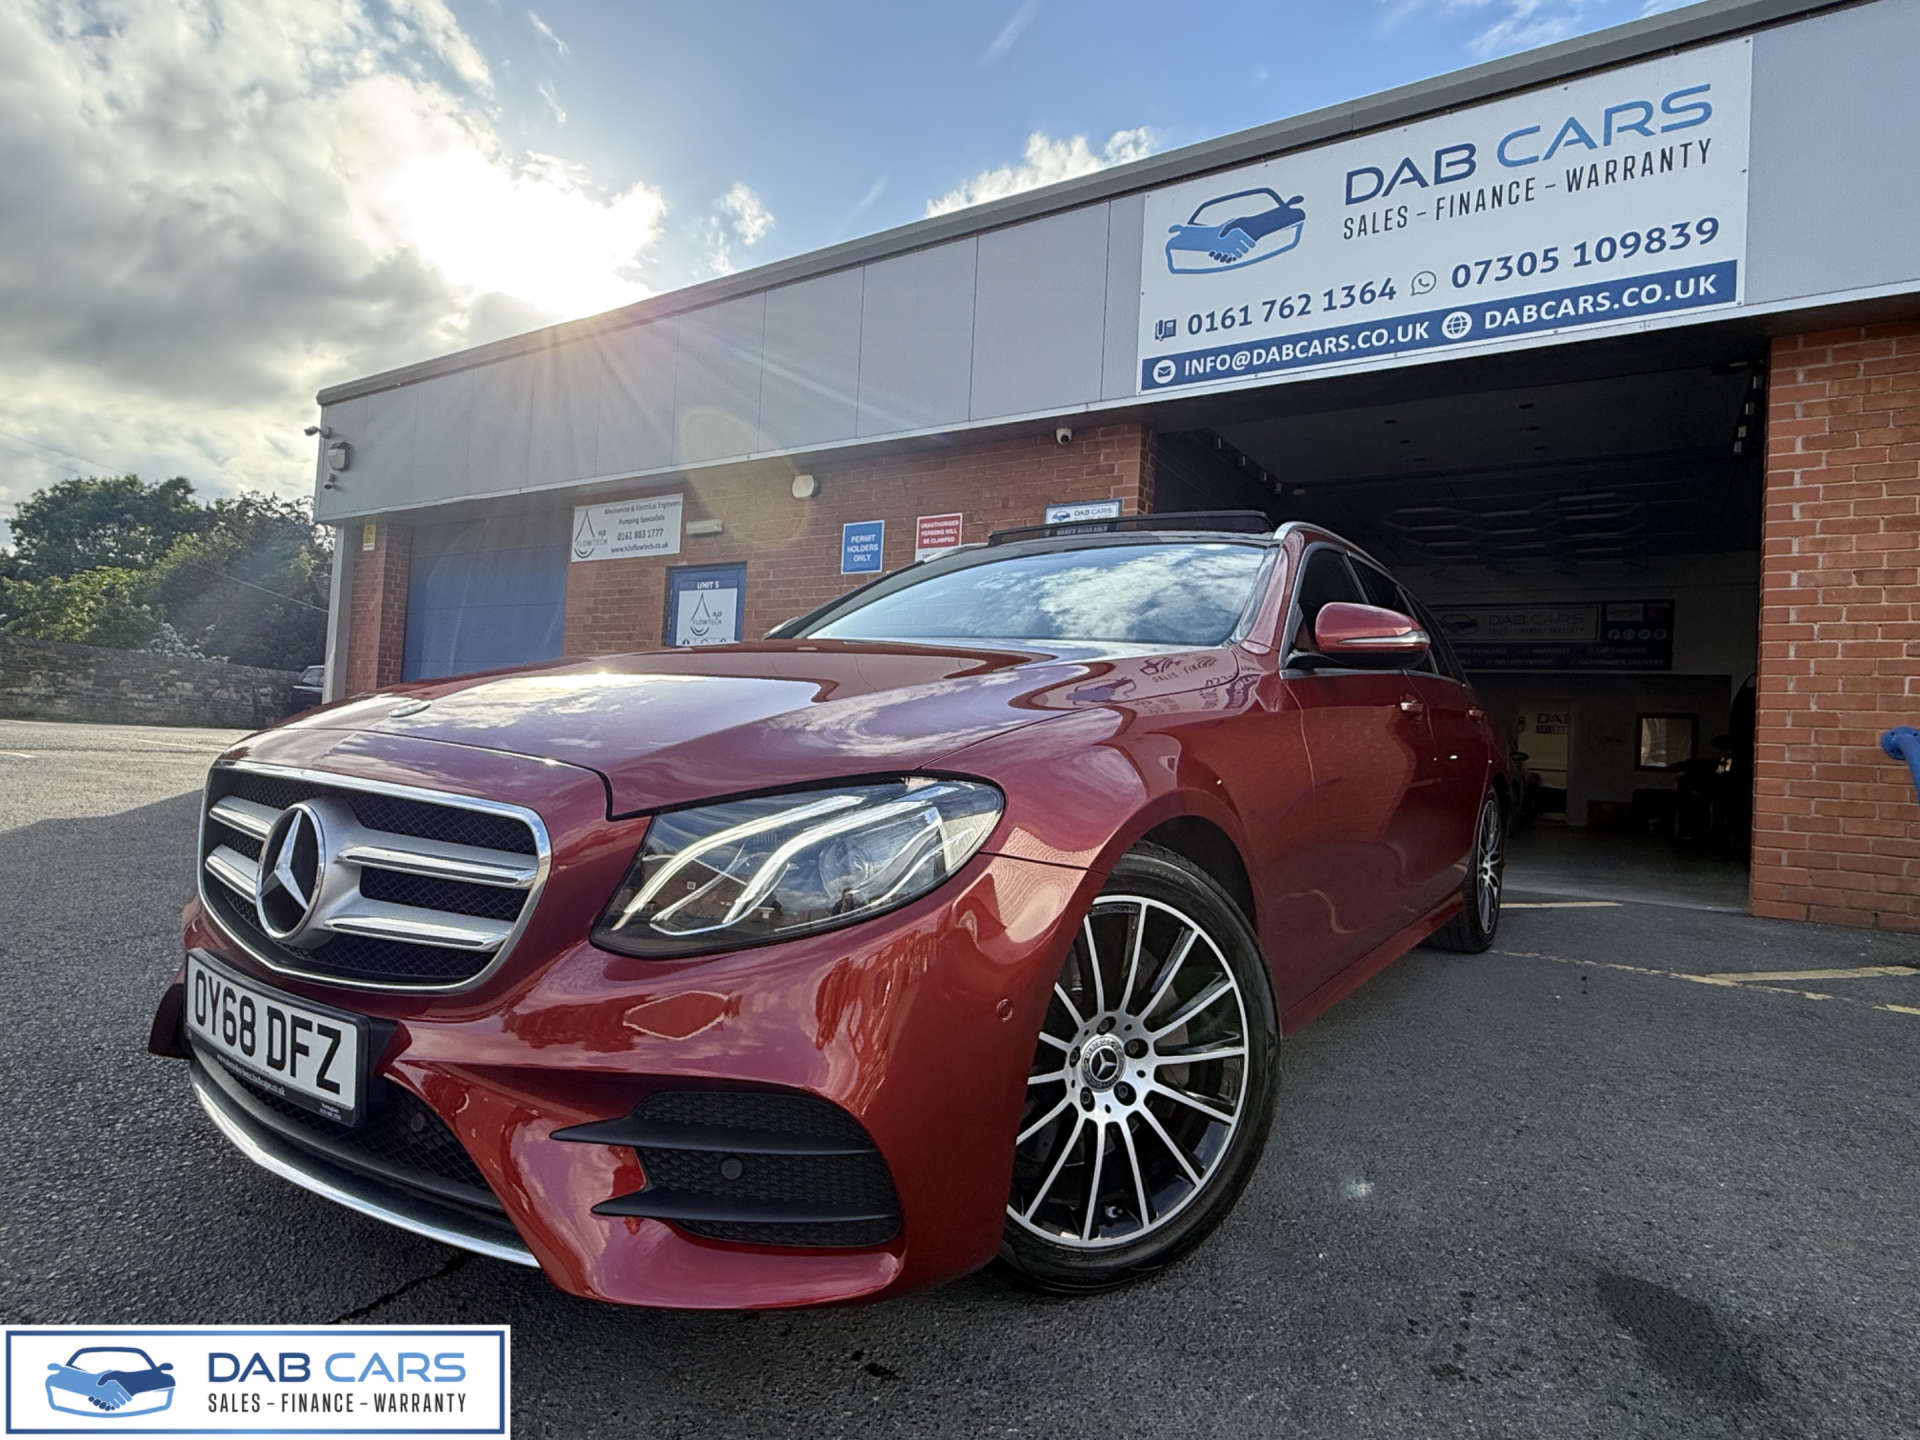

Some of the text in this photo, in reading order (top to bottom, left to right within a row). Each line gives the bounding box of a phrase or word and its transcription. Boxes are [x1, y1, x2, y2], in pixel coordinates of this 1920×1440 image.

[1345, 83, 1713, 205] DAB CARS
[1343, 205, 1408, 241] SALES
[1435, 177, 1536, 221] FINANCE
[1565, 138, 1713, 194] WARRANTY
[1450, 215, 1720, 290] 07305 109839
[1187, 277, 1397, 336] 0161 762 1364
[1483, 274, 1717, 331] DABCARS.CO.UK
[1183, 320, 1430, 378] INFO@DABCARS.CO.UK
[847, 543, 879, 552] HOLDERS
[851, 534, 876, 543] PERMIT
[853, 553, 872, 562] ONLY
[697, 581, 713, 589] UNIT
[195, 968, 256, 1057] OY68
[267, 1006, 342, 1095] DFZ
